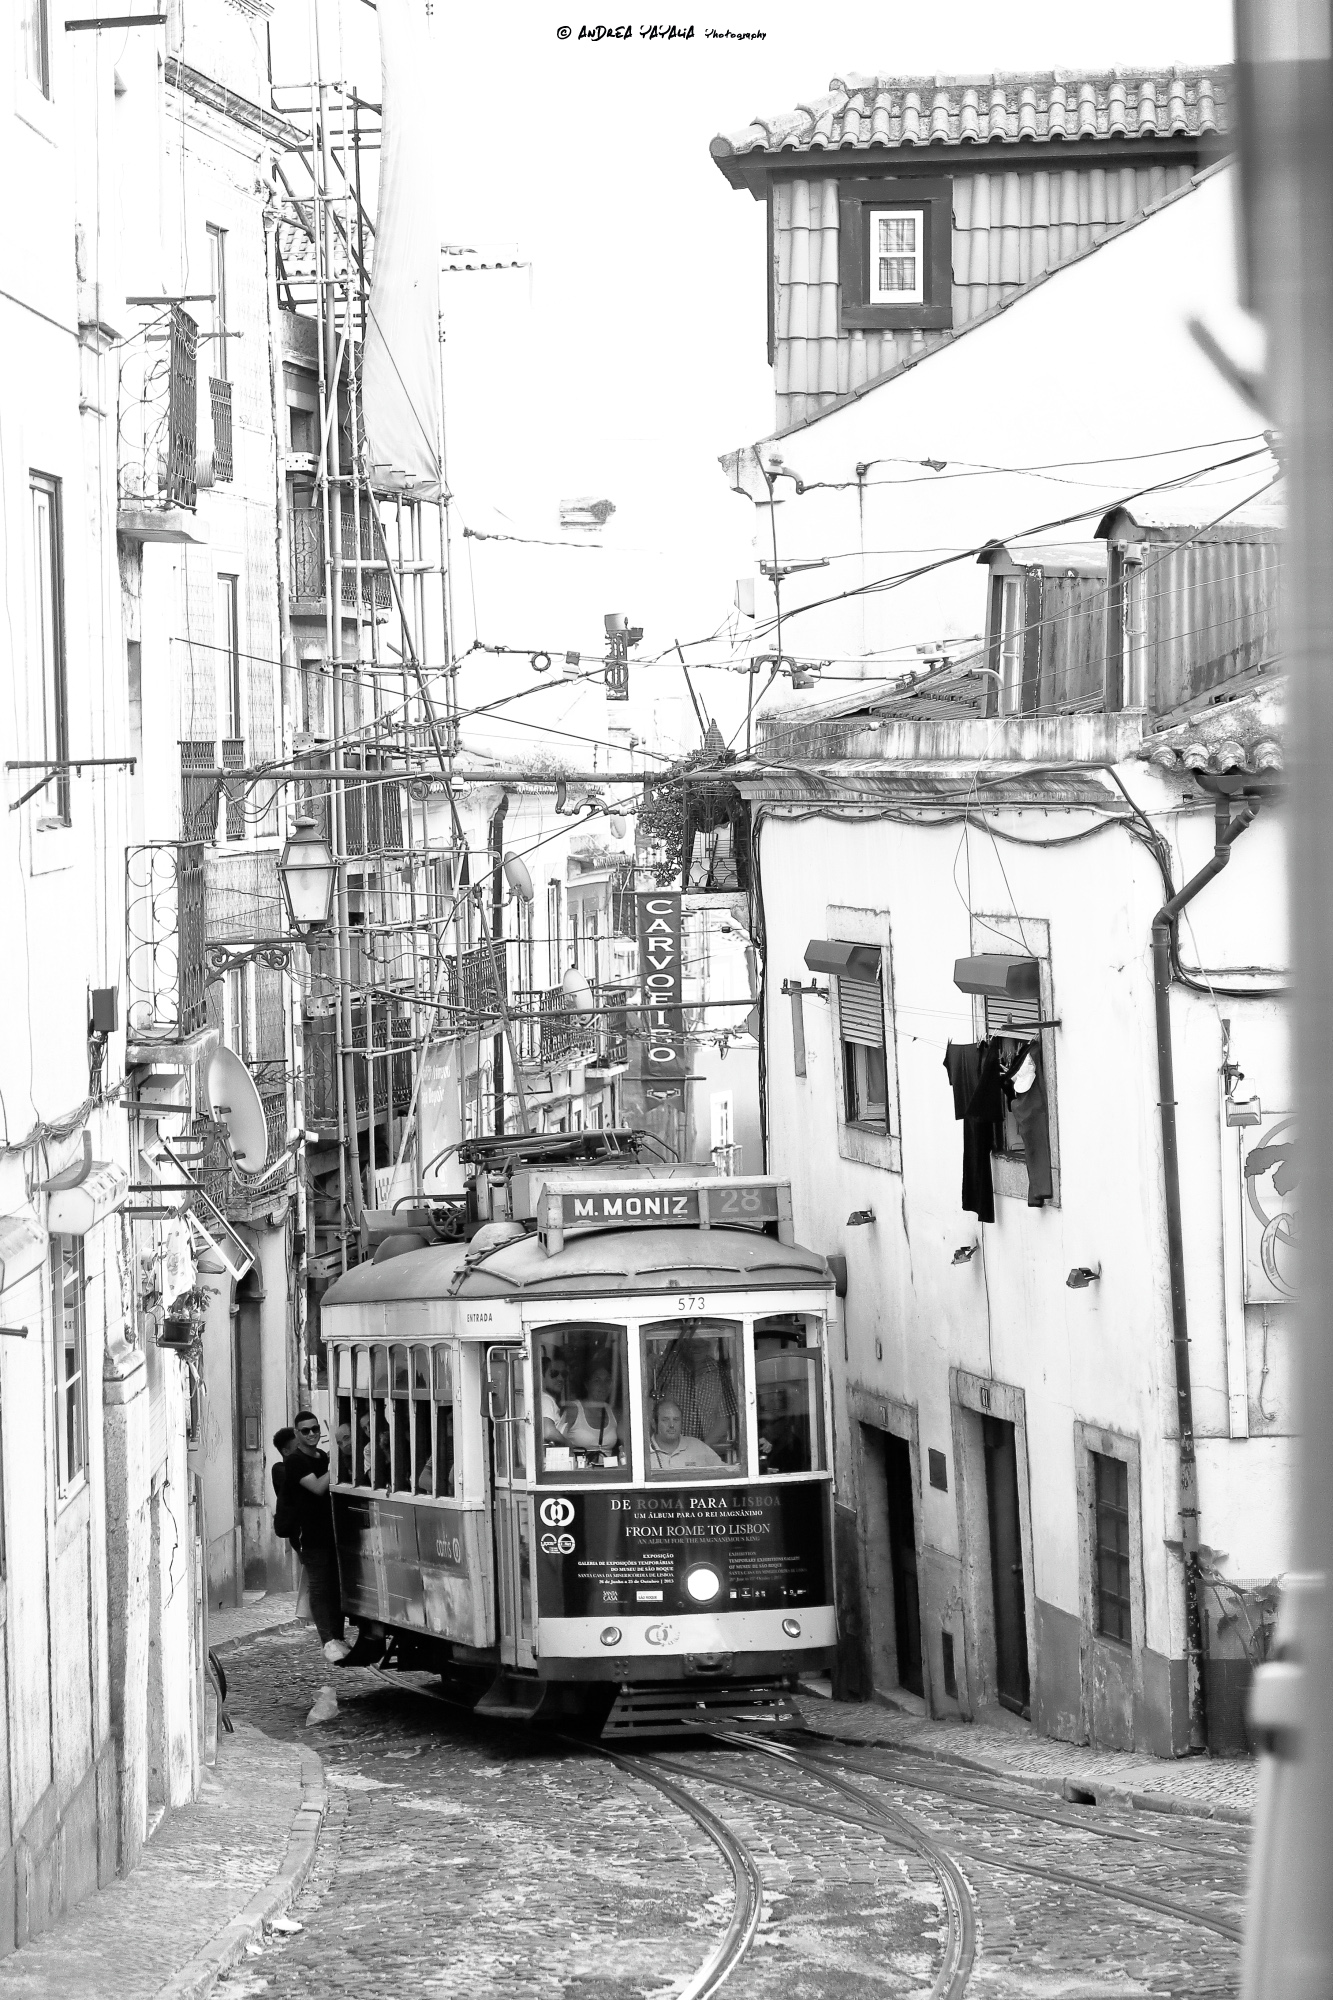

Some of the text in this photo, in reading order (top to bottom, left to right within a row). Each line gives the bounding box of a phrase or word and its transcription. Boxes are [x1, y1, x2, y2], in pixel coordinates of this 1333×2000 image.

[719, 1188, 762, 1213] 28
[678, 1297, 706, 1311] 573
[466, 1312, 493, 1323] ENTRADA
[610, 1495, 782, 1511] DE ROMA PARA LISBOA
[648, 1511, 674, 1519] ÁLBUM
[719, 1509, 763, 1517] MAGNÂNIMO
[625, 1523, 771, 1537] FROM ROME TO LISBON
